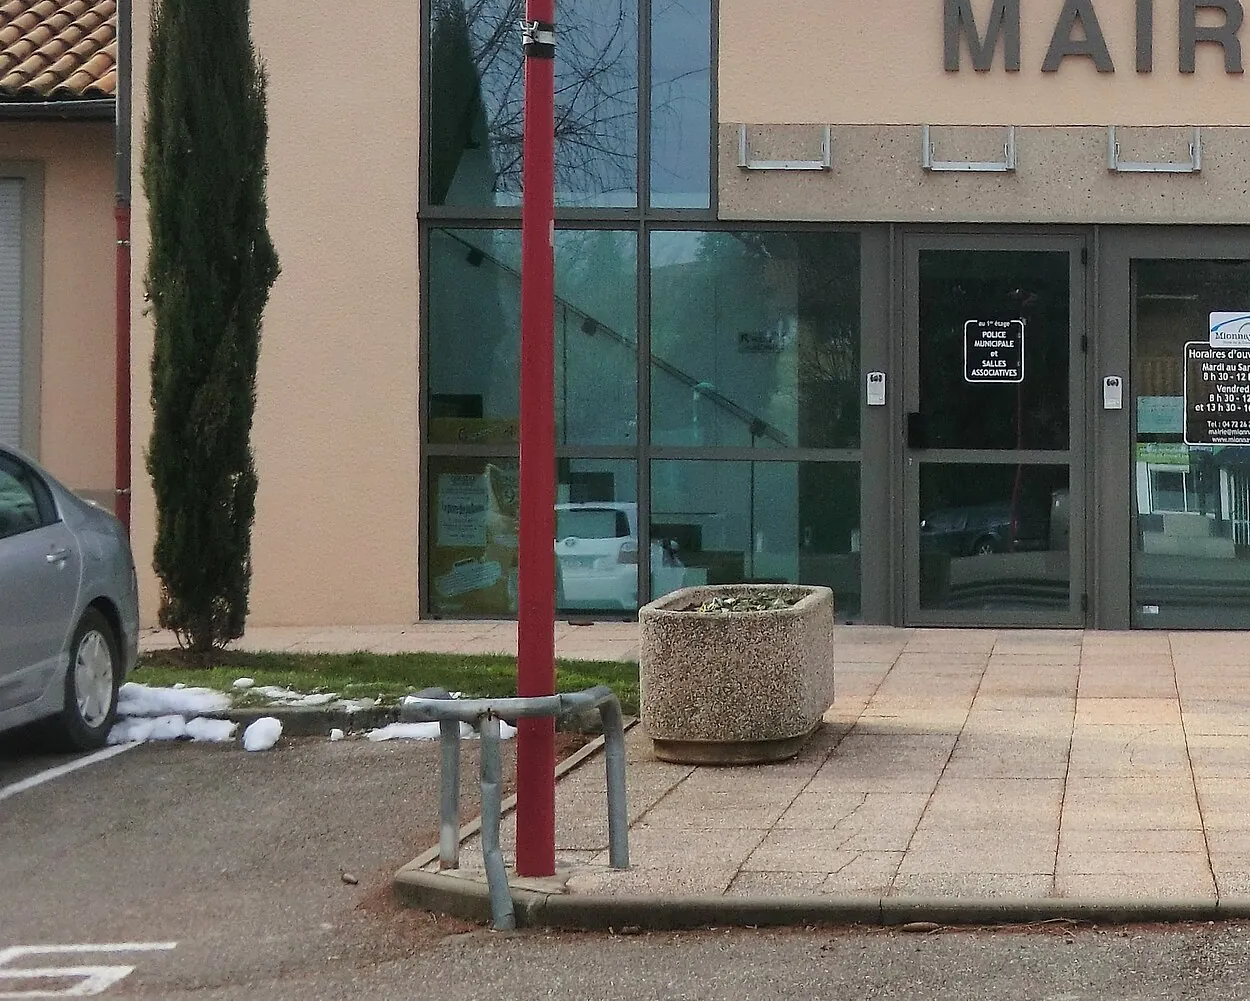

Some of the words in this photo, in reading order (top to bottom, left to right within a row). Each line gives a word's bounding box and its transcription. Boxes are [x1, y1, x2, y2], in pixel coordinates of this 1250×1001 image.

[1188, 349, 1226, 359] Horaires
[1202, 362, 1225, 371] Mardi
[1225, 363, 1236, 371] au
[1210, 372, 1216, 381] h
[1218, 372, 1229, 381] 30
[1236, 372, 1246, 381] 12
[1216, 394, 1222, 402] h
[1224, 394, 1235, 402] 30
[1195, 404, 1204, 412] et
[1206, 403, 1216, 412] 13
[1217, 403, 1224, 412] h
[1225, 403, 1236, 412] 30
